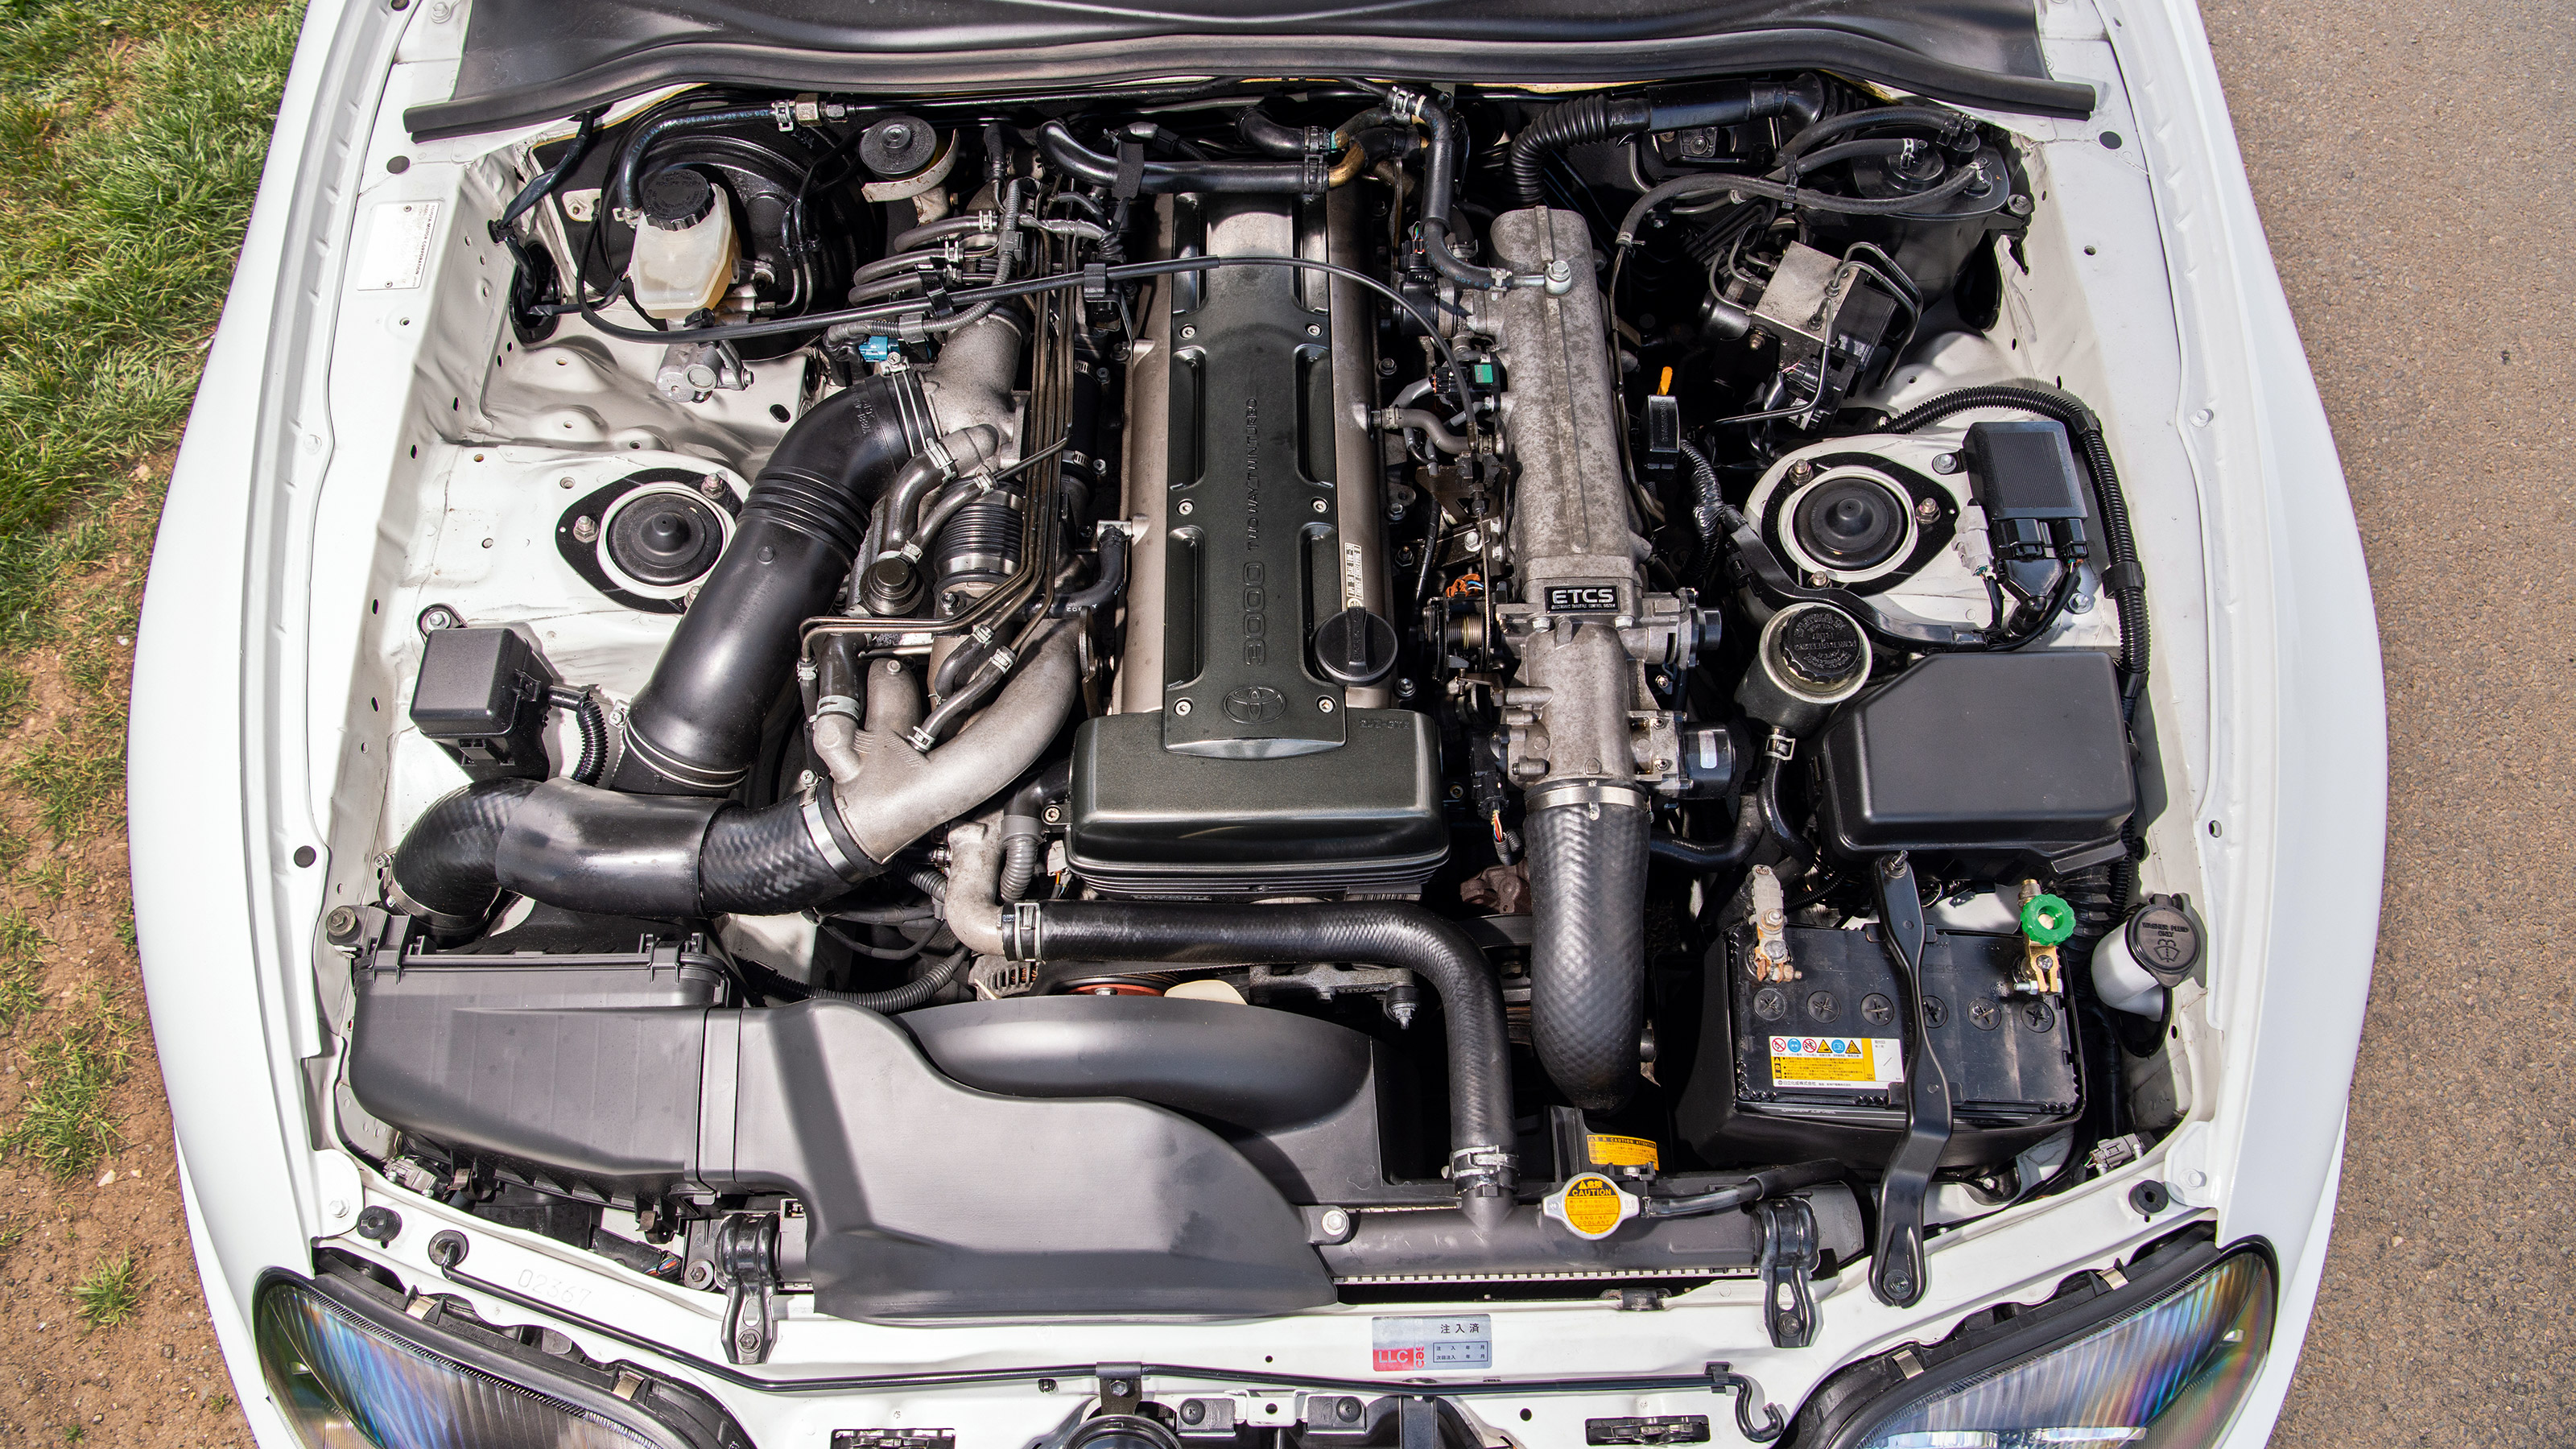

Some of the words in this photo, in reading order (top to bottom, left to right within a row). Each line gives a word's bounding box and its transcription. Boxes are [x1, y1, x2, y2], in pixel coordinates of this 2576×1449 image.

[427, 204, 436, 222] TOYOTA
[415, 241, 427, 275] CORPORATION
[1455, 275, 1472, 285] DOT
[1245, 398, 1258, 444] TURBO
[1246, 448, 1258, 482] TWIN
[1246, 486, 1258, 515] WAY
[1246, 518, 1258, 552] TWO
[1552, 588, 1614, 604] ETCS
[1243, 562, 1265, 666] 3000
[1794, 642, 1830, 650] STEERING
[1831, 640, 1857, 648] POWER
[2141, 922, 2169, 931] WASHER
[2170, 924, 2190, 932] FLUID
[1636, 1140, 1655, 1148] ATTENTION
[1587, 1180, 1603, 1189] 危険
[1571, 1188, 1612, 1197] CAUTION
[517, 1269, 592, 1307] 02367
[1440, 1323, 1480, 1334] 注入済
[1378, 1350, 1409, 1364] LLC
